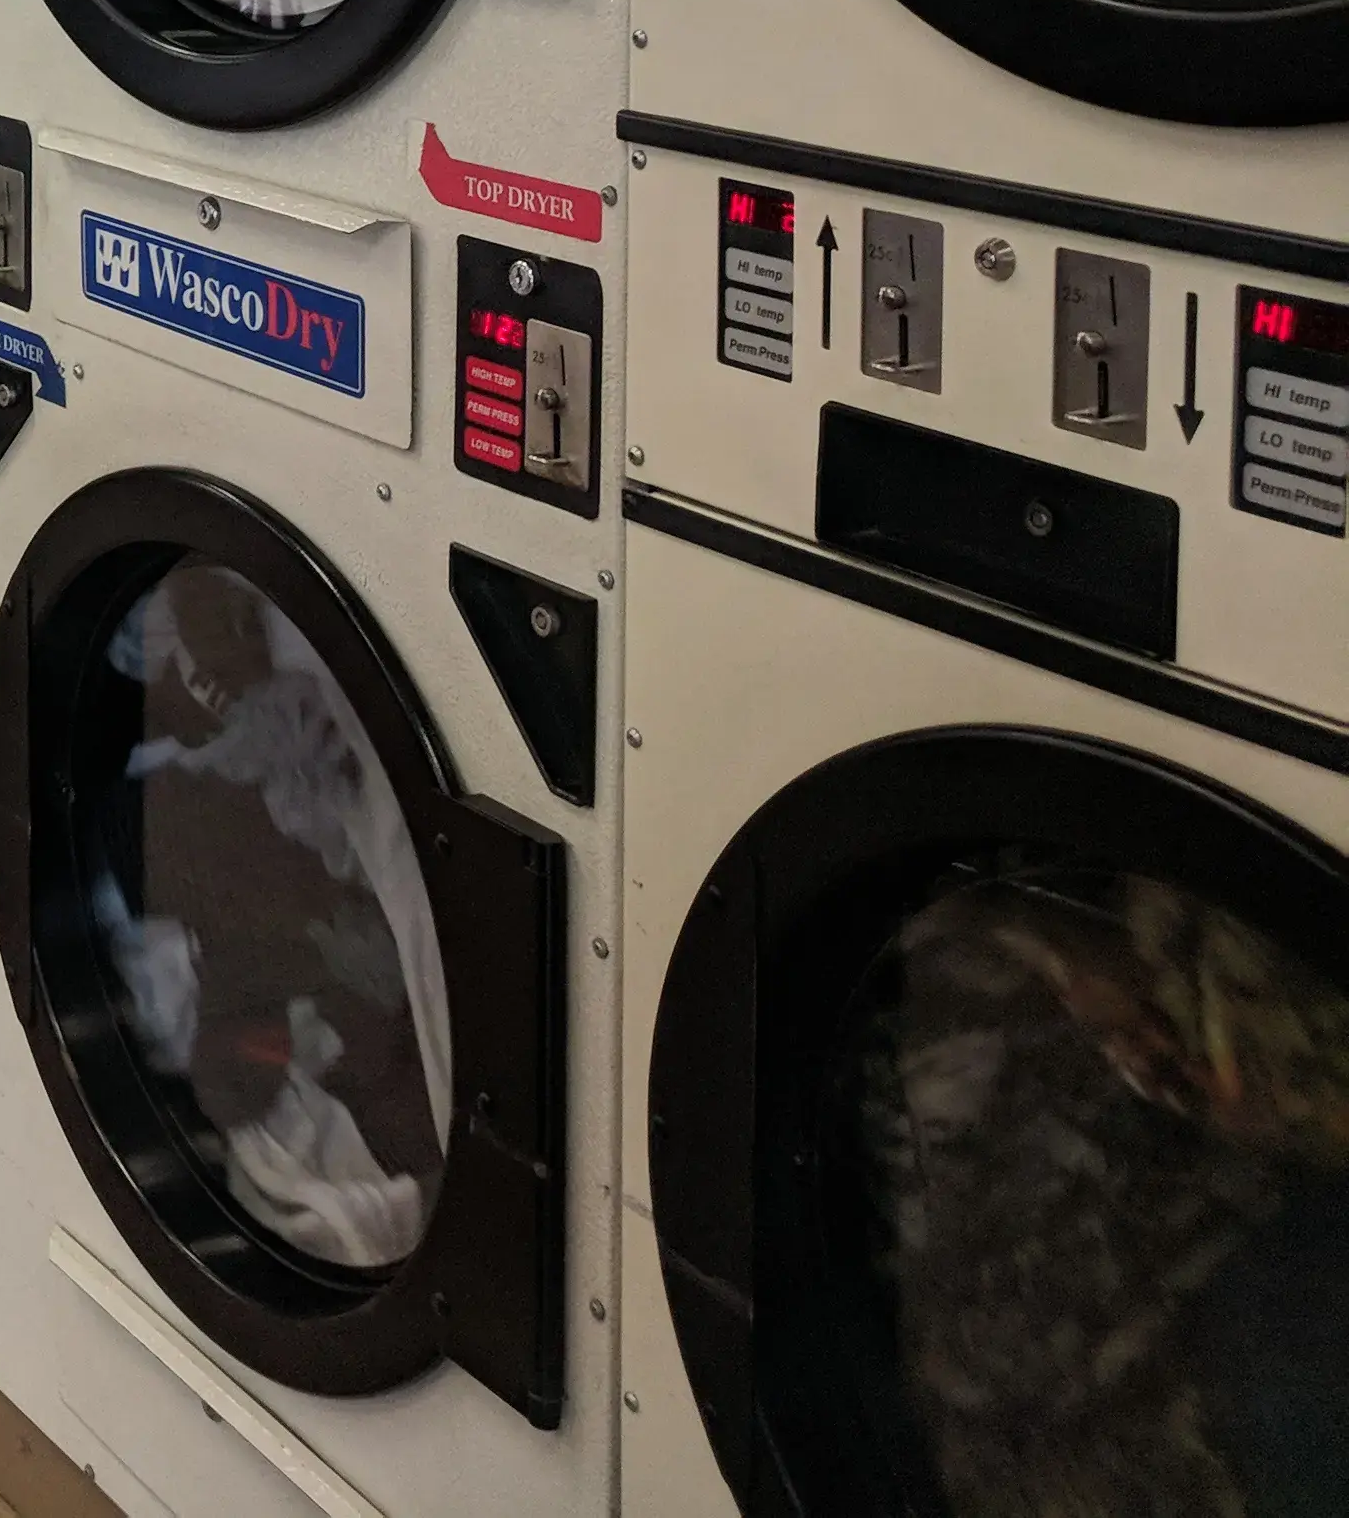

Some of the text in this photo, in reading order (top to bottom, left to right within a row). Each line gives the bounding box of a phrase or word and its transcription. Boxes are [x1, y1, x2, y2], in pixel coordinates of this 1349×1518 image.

[464, 175, 575, 222] TOP DRYER
[738, 259, 783, 282] HI temp
[145, 242, 344, 371] WascoDry
[735, 300, 784, 323] LO temp
[1254, 300, 1294, 342] HI
[3, 334, 44, 364] DRYER
[729, 338, 789, 364] Perm Press
[471, 366, 516, 388] HIGH TEMP
[1264, 382, 1331, 412] HI temp
[467, 401, 520, 427] PERM PRESS
[470, 438, 514, 459] LOW TEMP
[1259, 431, 1333, 463] LO temp
[1251, 477, 1341, 514] Perm Press
